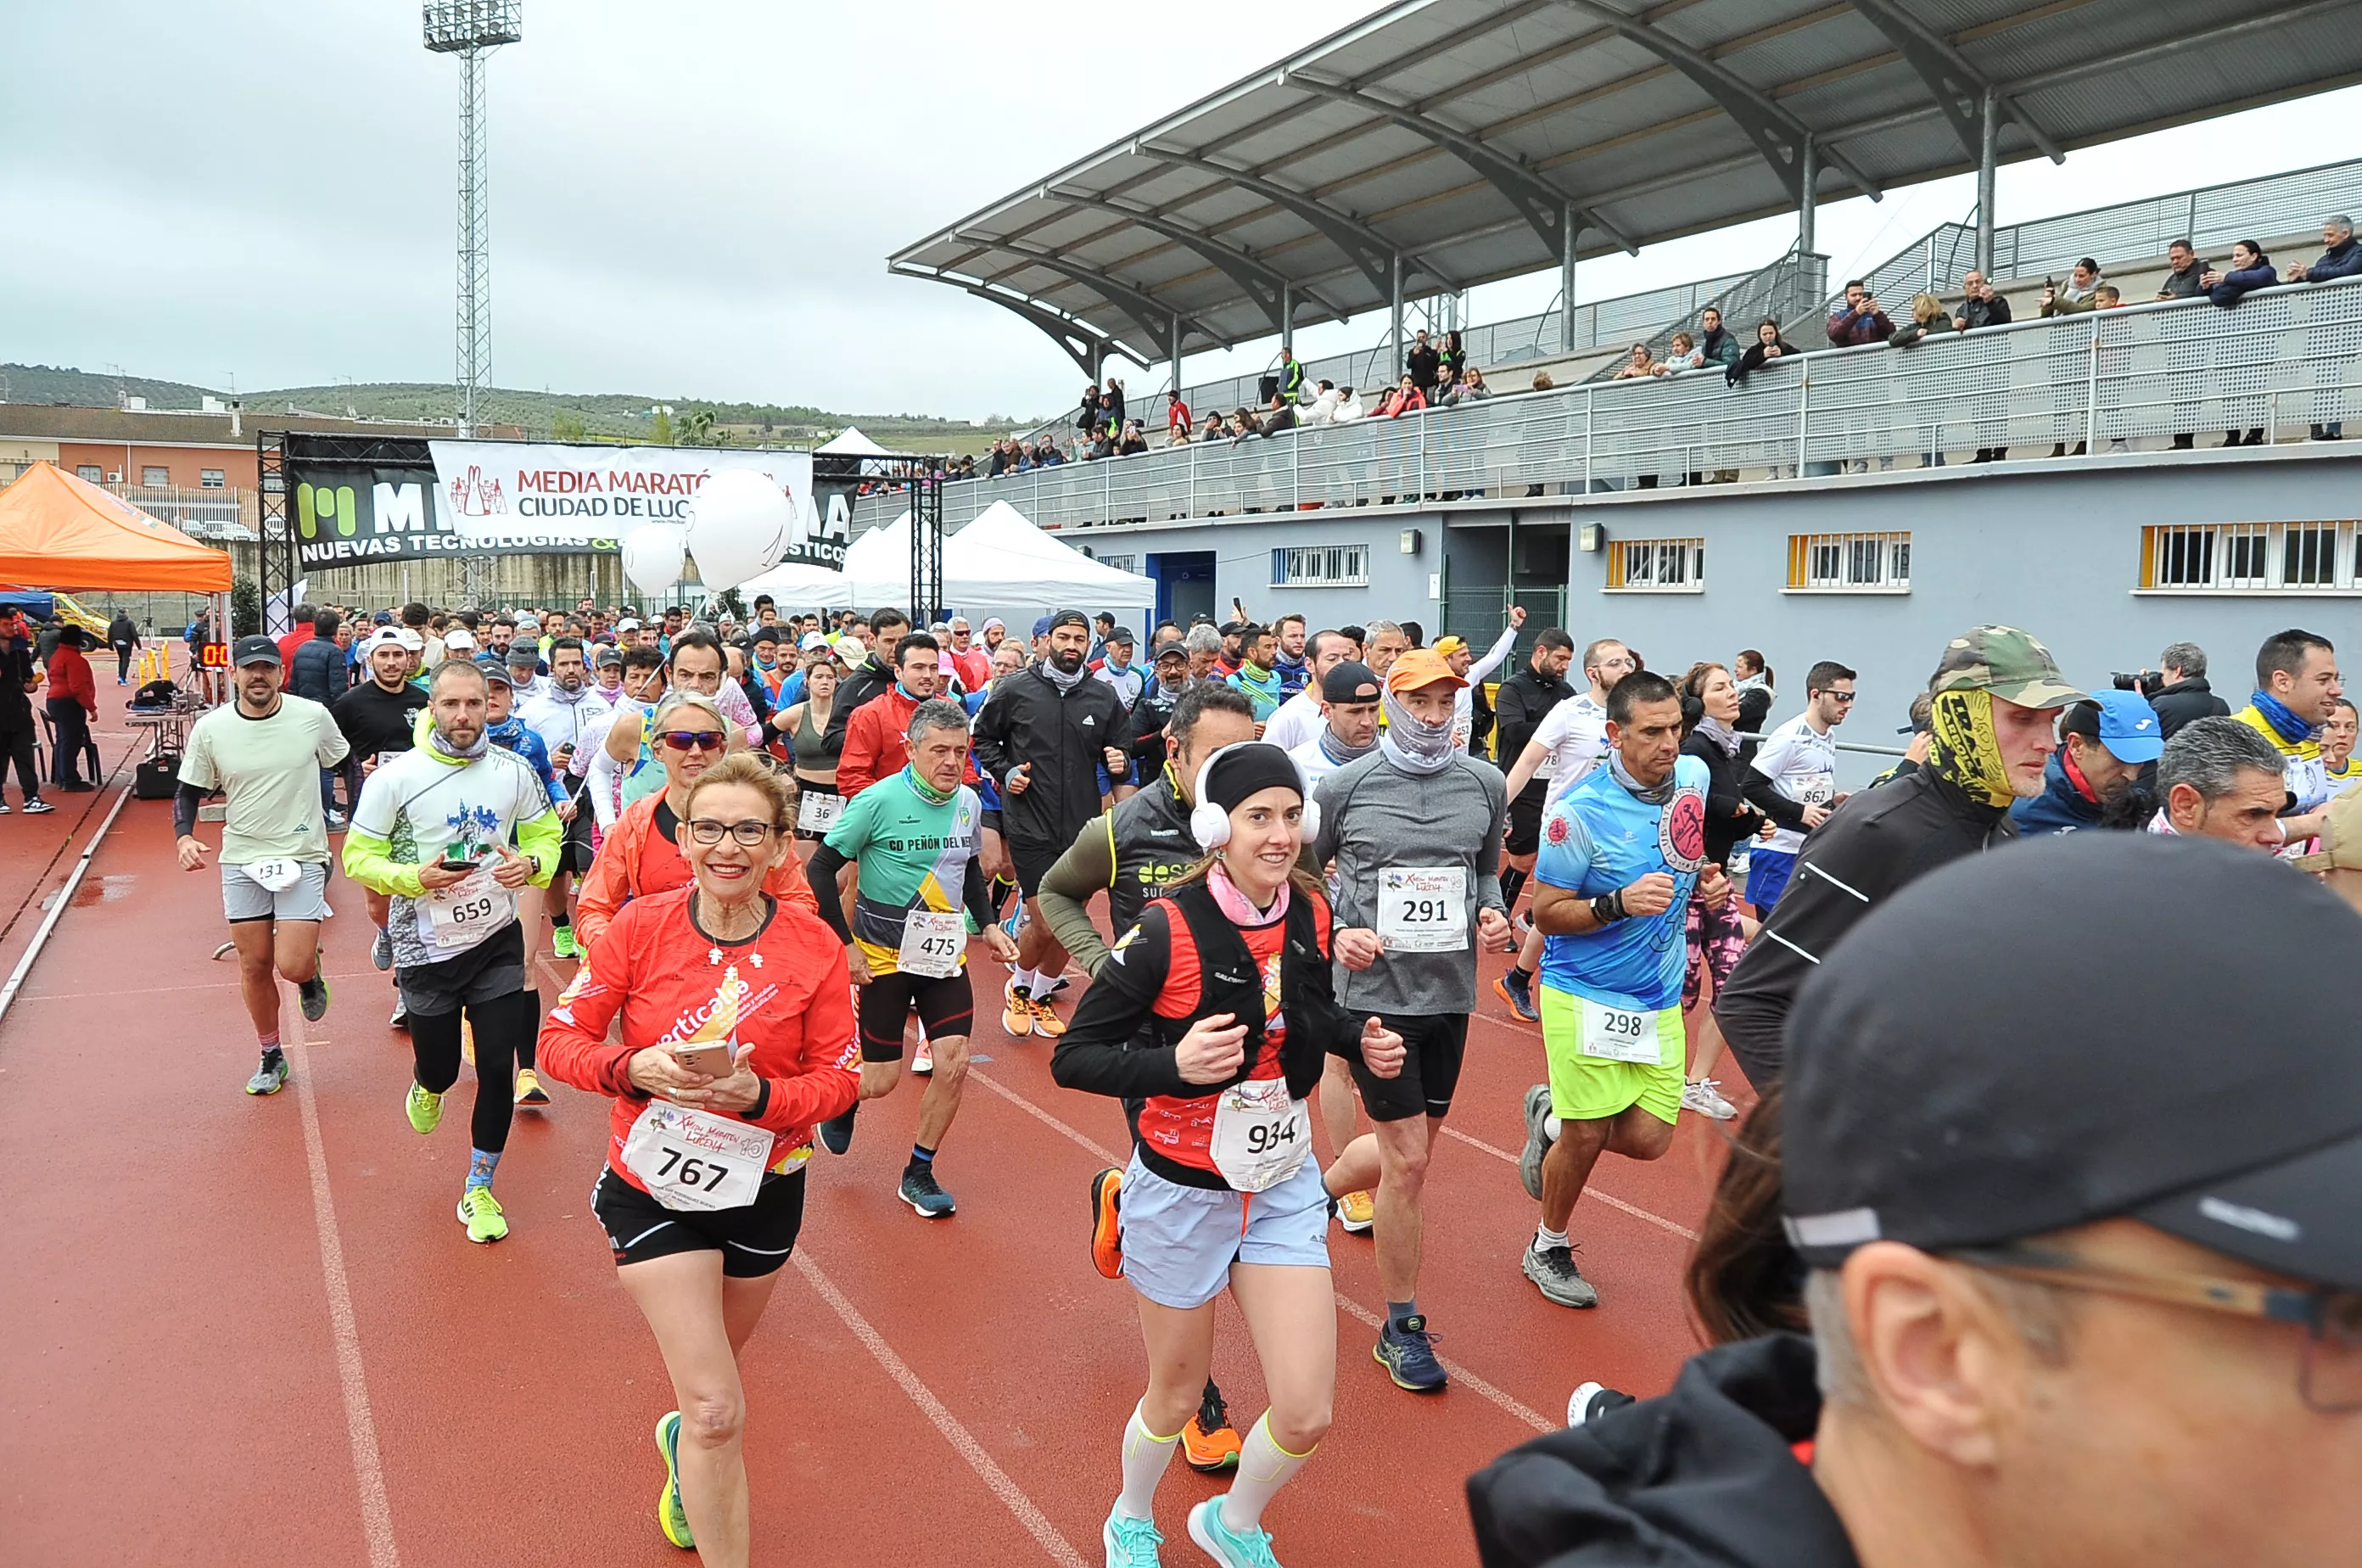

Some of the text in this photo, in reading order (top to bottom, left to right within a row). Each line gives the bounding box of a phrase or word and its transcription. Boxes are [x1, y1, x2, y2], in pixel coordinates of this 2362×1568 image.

[518, 471, 603, 494] MEDIA
[518, 496, 690, 519] CIUDAD DE LUC
[302, 535, 401, 563] NUEVAS
[814, 807, 831, 819] 36
[889, 839, 904, 852] CD
[907, 833, 940, 851] PEÑÓN
[943, 837, 960, 848] DEL
[452, 898, 492, 924] 659
[1402, 899, 1448, 922] 291
[920, 937, 955, 956] 475
[1604, 1011, 1642, 1037] 298
[1246, 1115, 1296, 1155] 934
[657, 1146, 730, 1193] 767
